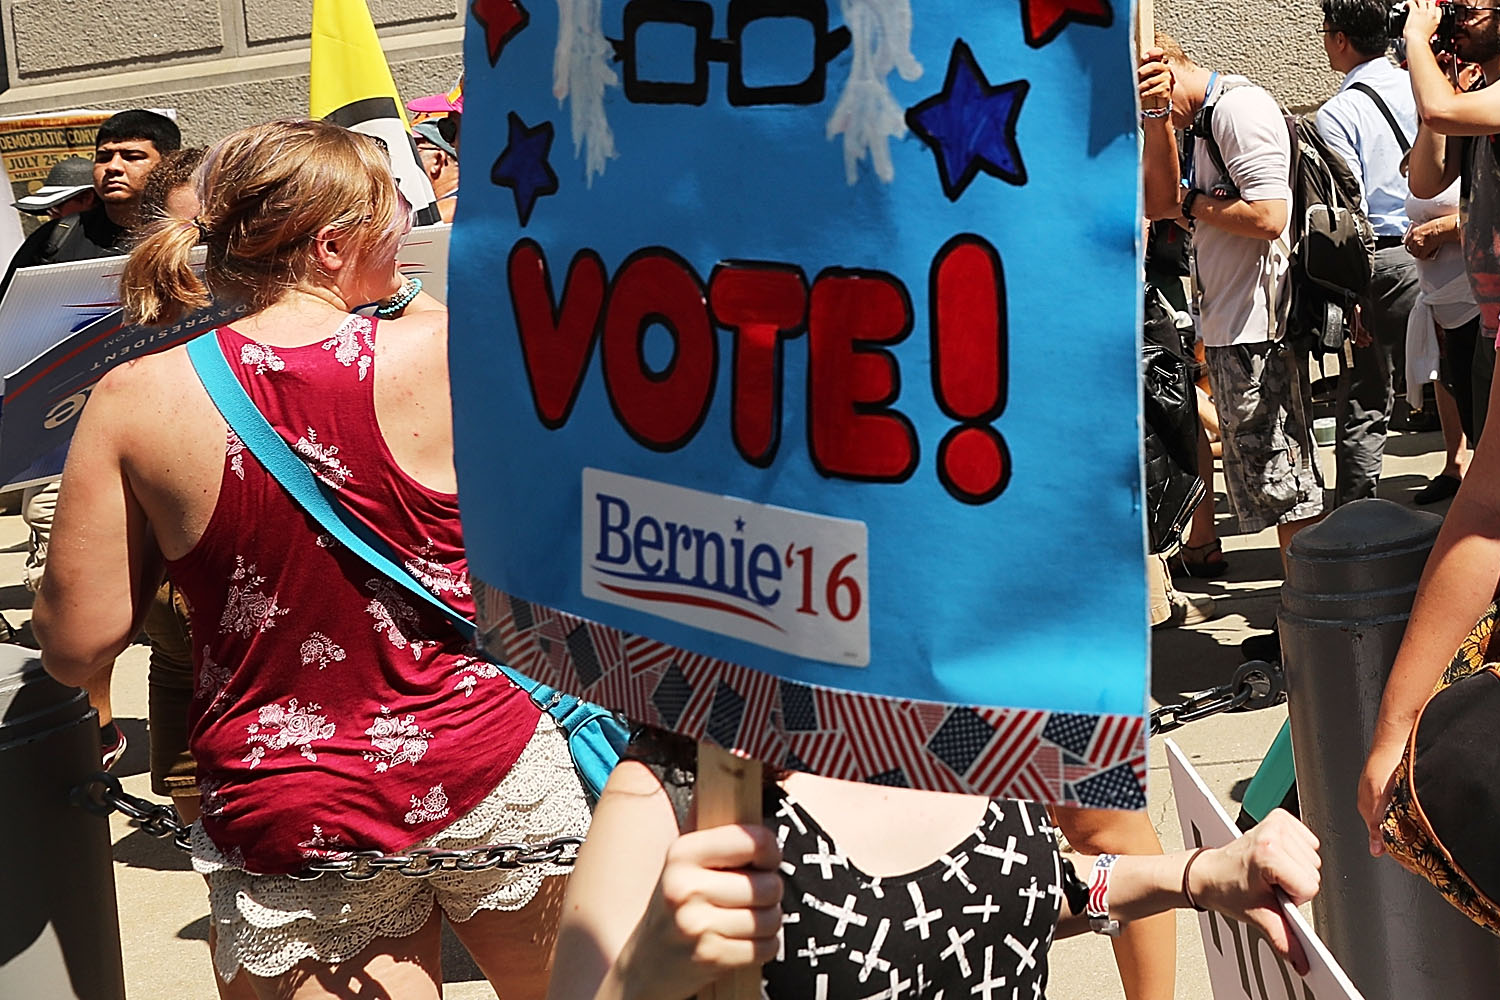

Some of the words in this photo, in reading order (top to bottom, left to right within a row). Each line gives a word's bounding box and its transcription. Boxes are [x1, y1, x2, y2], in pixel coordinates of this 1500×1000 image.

[0, 131, 67, 151] DEMOCRATIC
[8, 156, 39, 171] JULY
[90, 315, 211, 372] PRESIDENT
[507, 232, 1012, 505] VOTE!
[595, 493, 783, 607] Bernie
